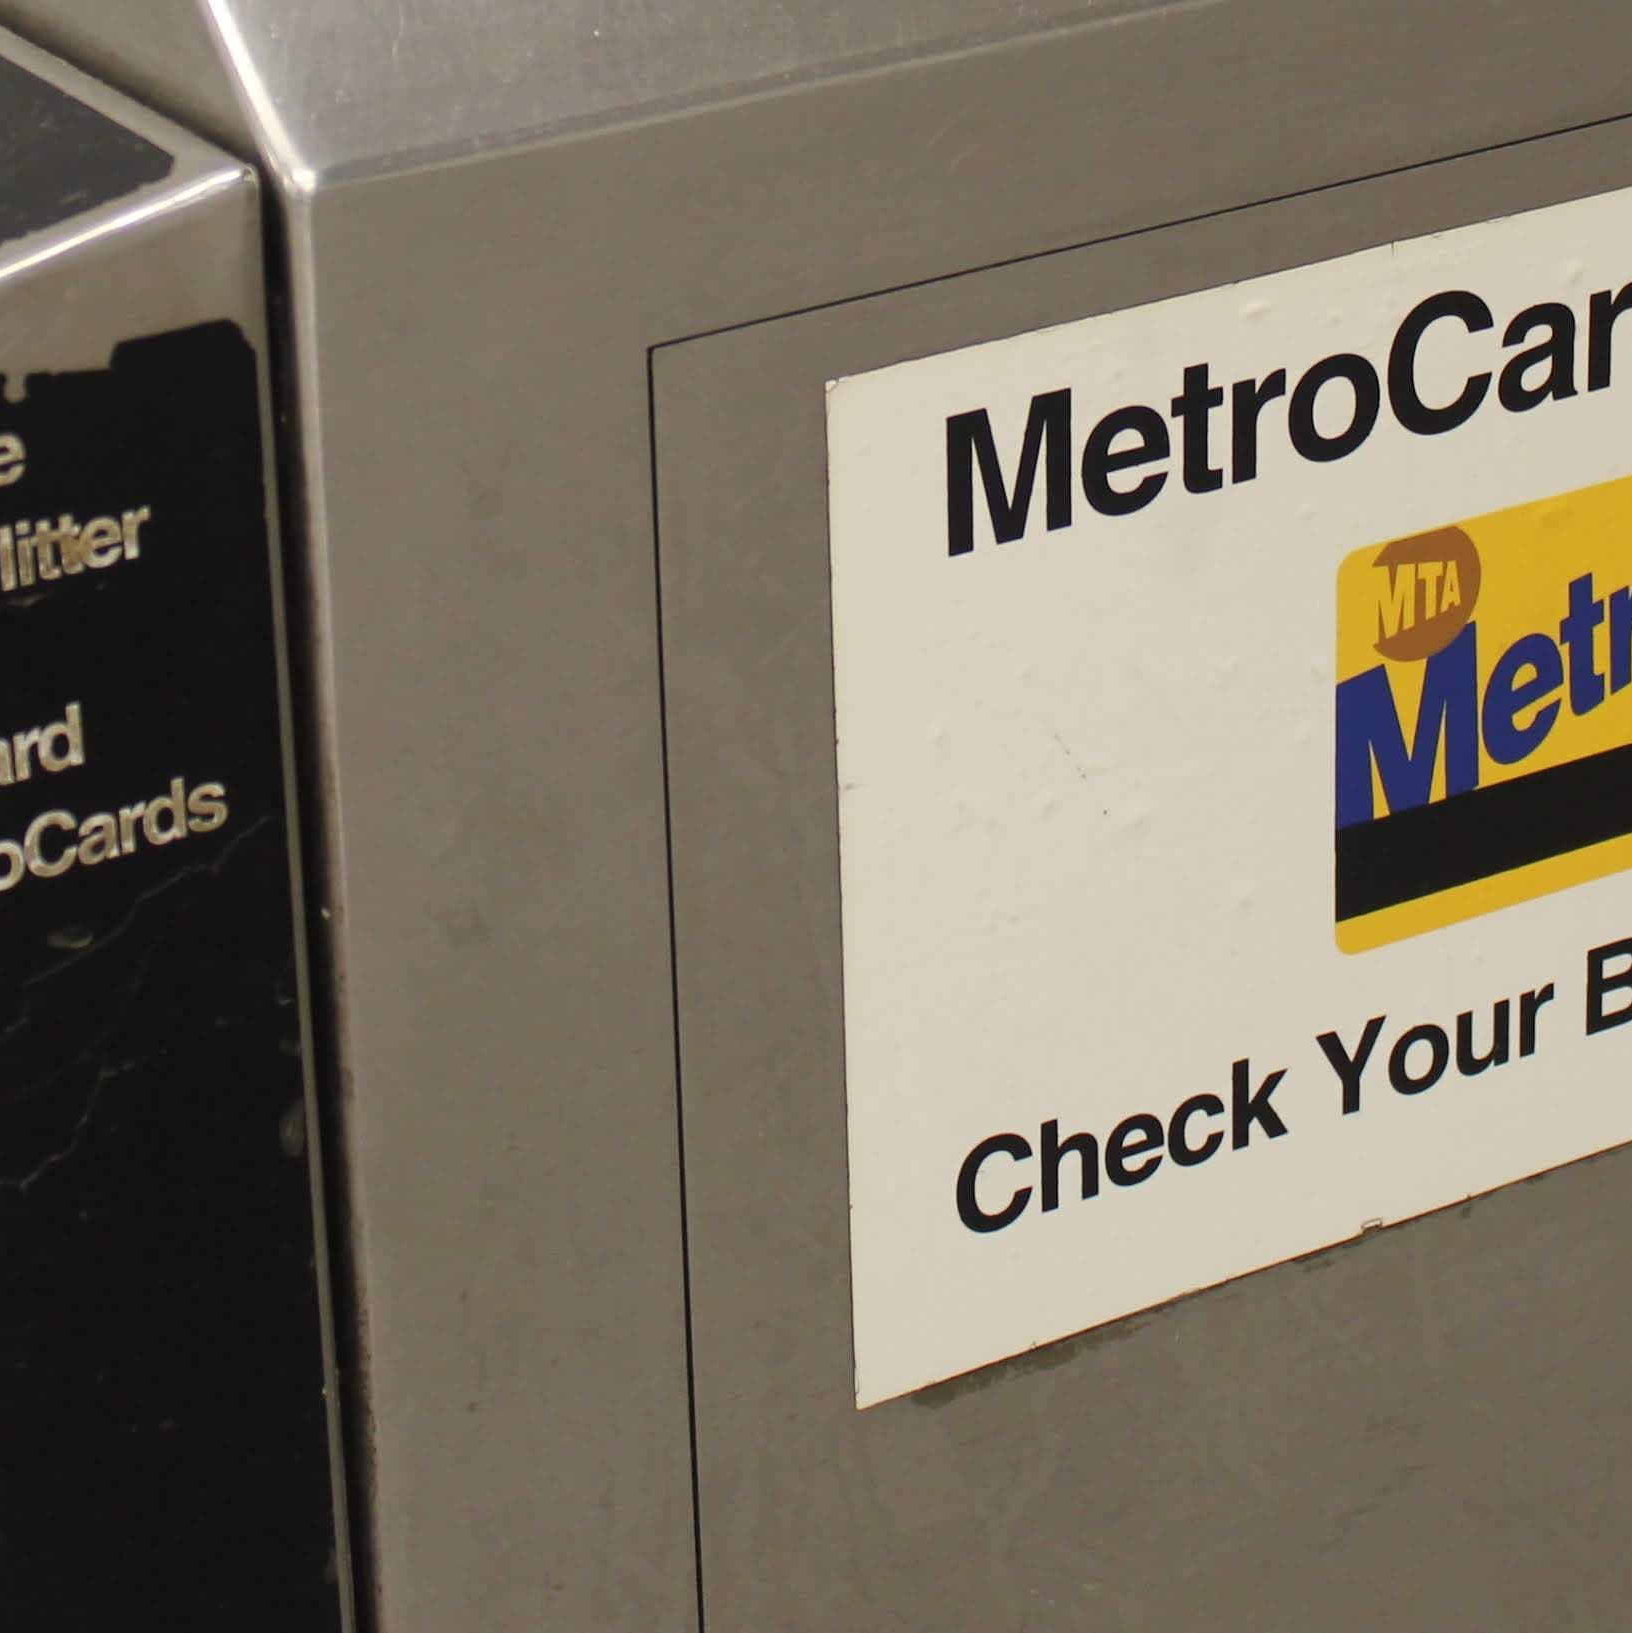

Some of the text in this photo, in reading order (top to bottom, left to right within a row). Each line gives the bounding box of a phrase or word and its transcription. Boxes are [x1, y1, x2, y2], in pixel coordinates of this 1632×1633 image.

[1372, 560, 1461, 640] MTA
[955, 1058, 1289, 1237] Check
[1318, 980, 1556, 1115] Your
